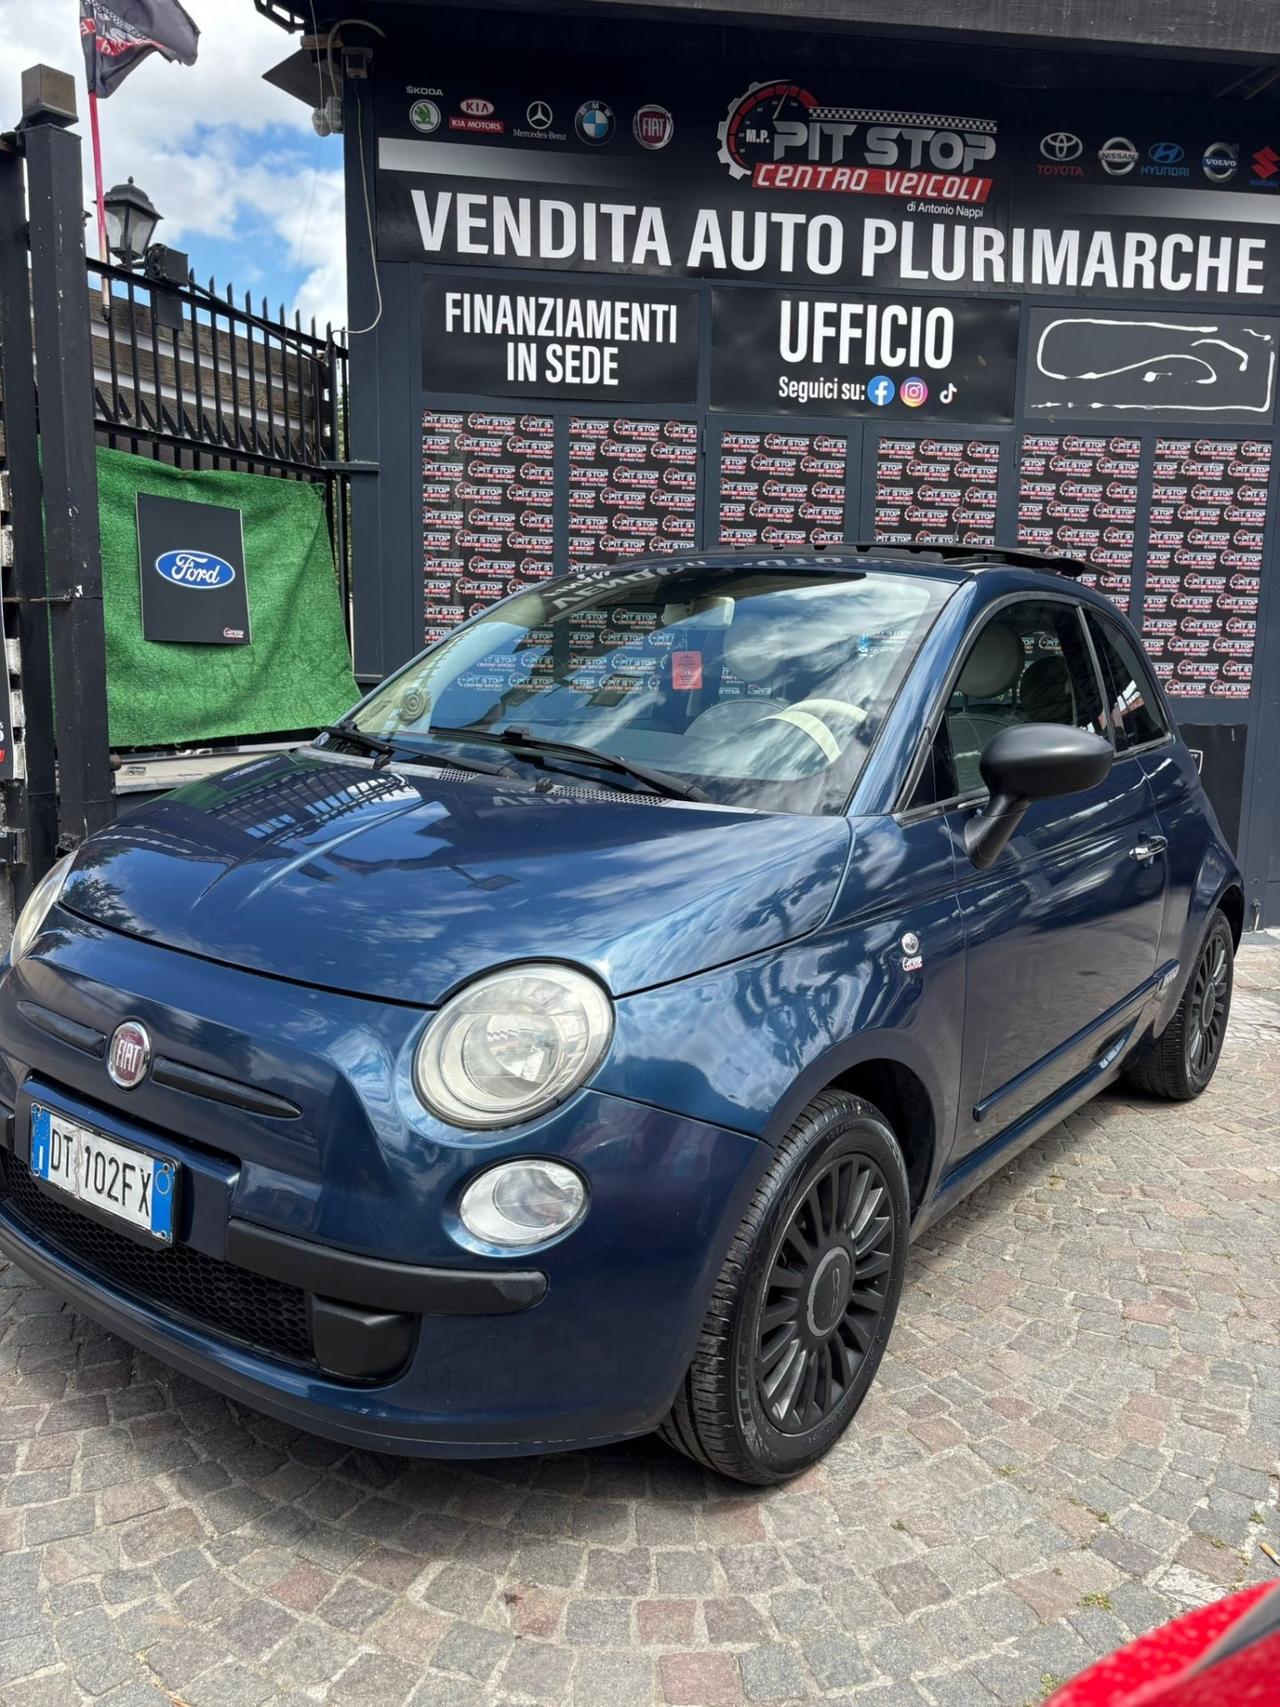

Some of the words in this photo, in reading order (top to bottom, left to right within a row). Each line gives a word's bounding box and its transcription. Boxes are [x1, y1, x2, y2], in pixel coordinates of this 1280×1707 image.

[406, 85, 443, 96] ŠKODA
[465, 102, 490, 114] KIA
[451, 119, 467, 128] KIA
[467, 120, 501, 130] MOTORS
[513, 128, 567, 141] Mercedes-Benz
[643, 118, 666, 138] FIAT
[772, 120, 858, 164] PIT
[863, 127, 997, 174] STOP
[1101, 151, 1136, 161] NISSAN
[1037, 164, 1084, 176] TOYOTA
[1140, 165, 1190, 177] HYUNDAI
[1204, 157, 1237, 167] VOLVO
[907, 201, 916, 212] di
[917, 202, 954, 215] Antonio
[955, 205, 984, 219] Nappi
[410, 189, 672, 267] VENDITA
[686, 208, 844, 276] AUTO
[861, 217, 1266, 294] PLURIMARCHE
[445, 292, 677, 343] FINANZIAMENTI
[779, 300, 954, 369] UFFICIO
[507, 341, 537, 382] IN
[545, 342, 619, 386] SEDE
[778, 375, 839, 403] Seguici
[841, 383, 866, 401] su:
[171, 554, 221, 583] Ford
[116, 1040, 142, 1072] FIAT
[50, 1128, 73, 1179] DT
[84, 1145, 152, 1217] 102FX
